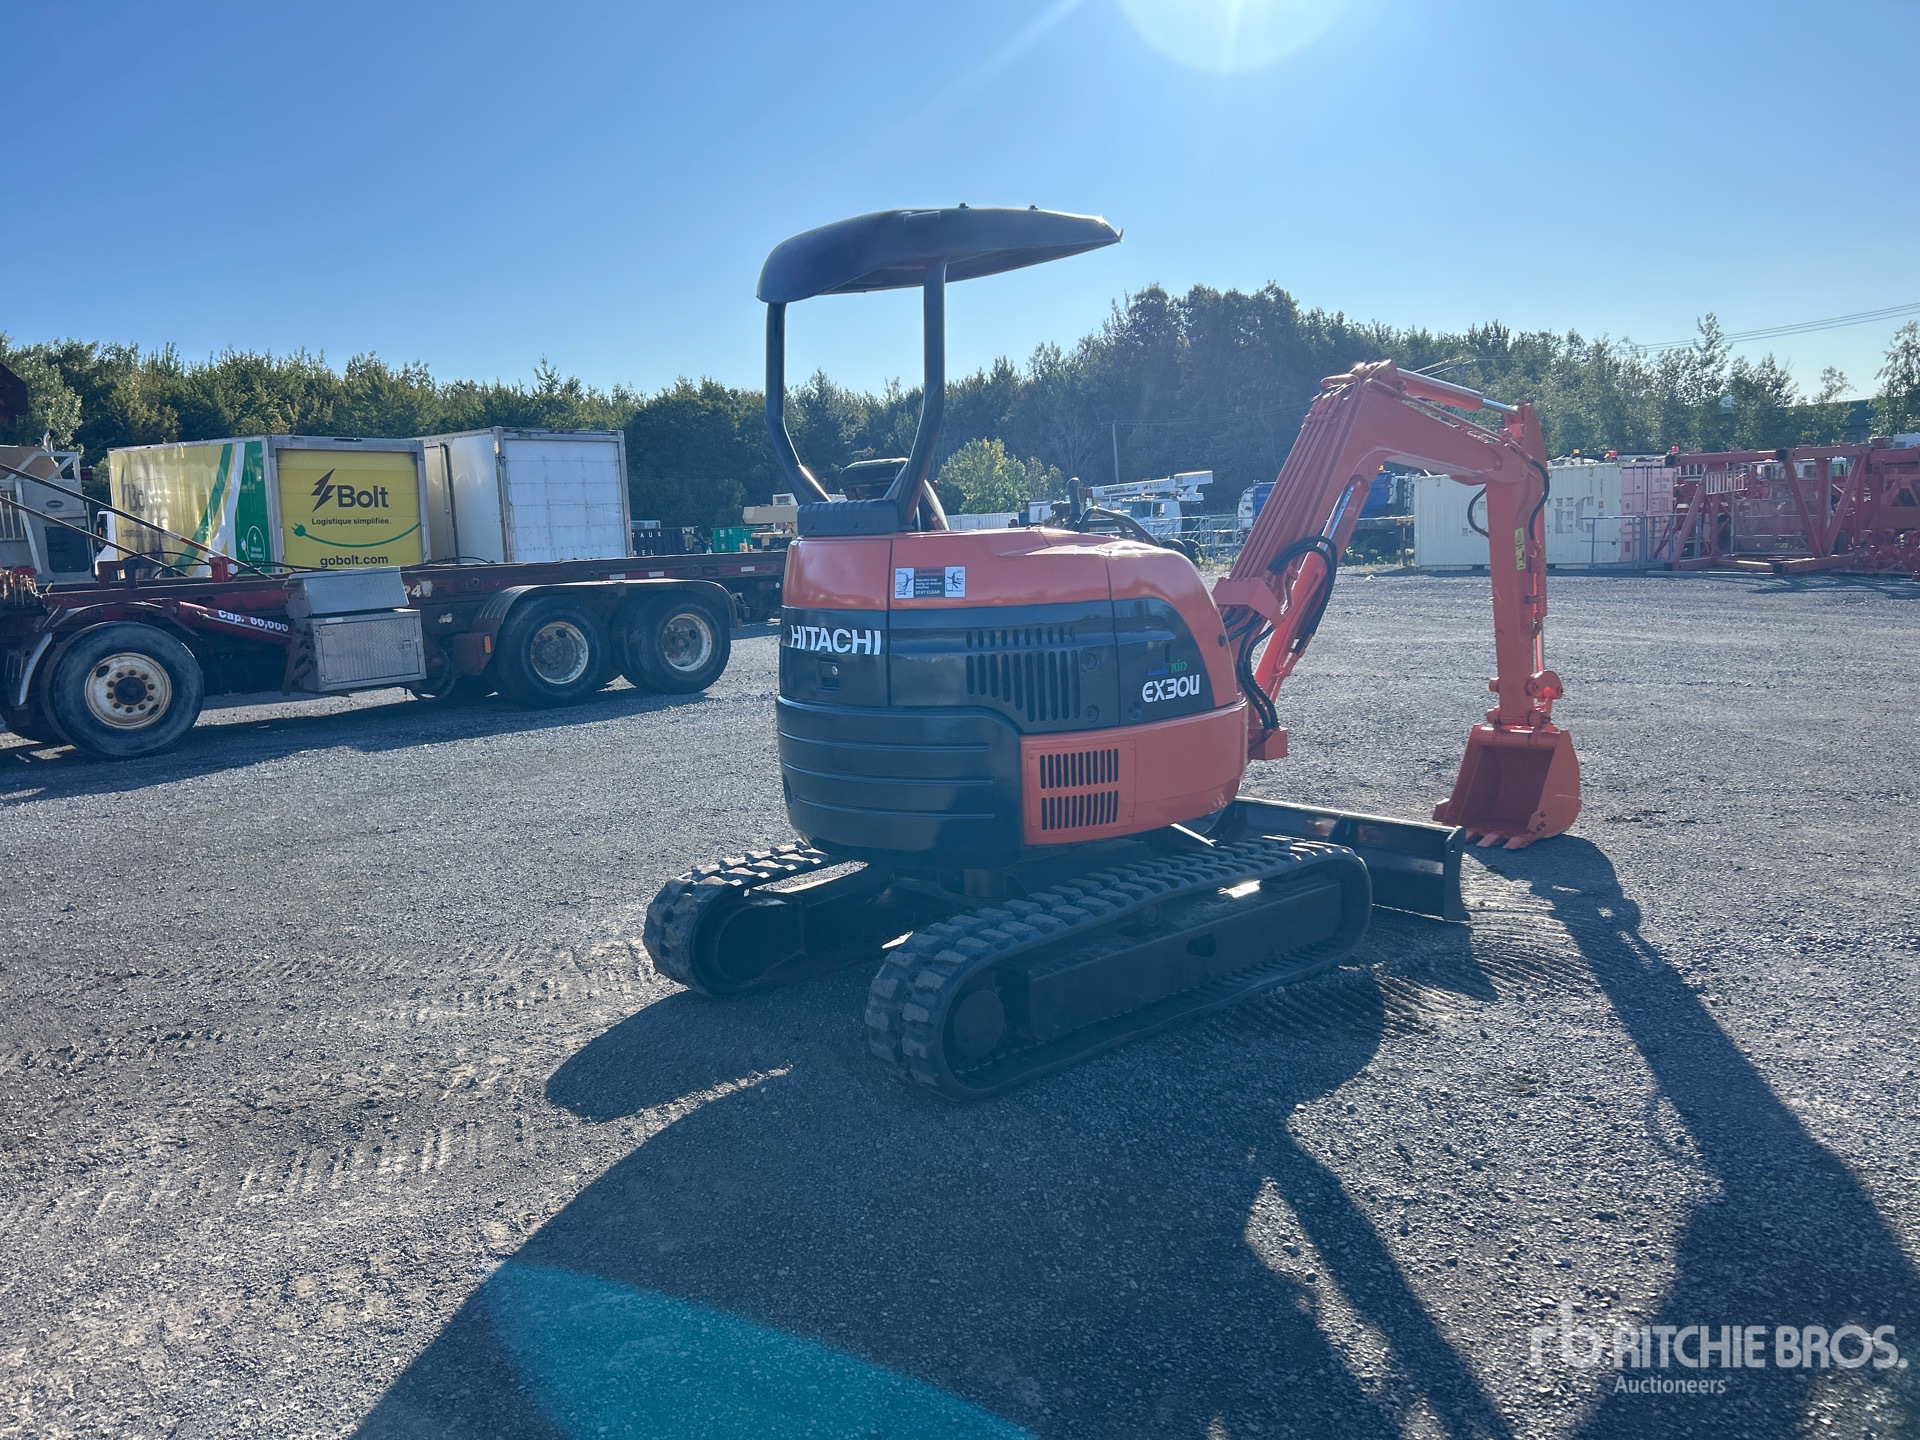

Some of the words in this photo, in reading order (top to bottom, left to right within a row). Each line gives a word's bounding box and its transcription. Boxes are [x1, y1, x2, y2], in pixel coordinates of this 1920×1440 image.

[337, 485, 389, 508] Bolt
[311, 517, 352, 526] Logistique
[353, 517, 391, 526] simplifiée.
[320, 555, 389, 568] gobolt.com
[218, 609, 245, 624] Cap.
[250, 616, 289, 632] 60,000
[790, 625, 882, 655] HITACHI
[1142, 674, 1200, 703] EX30U
